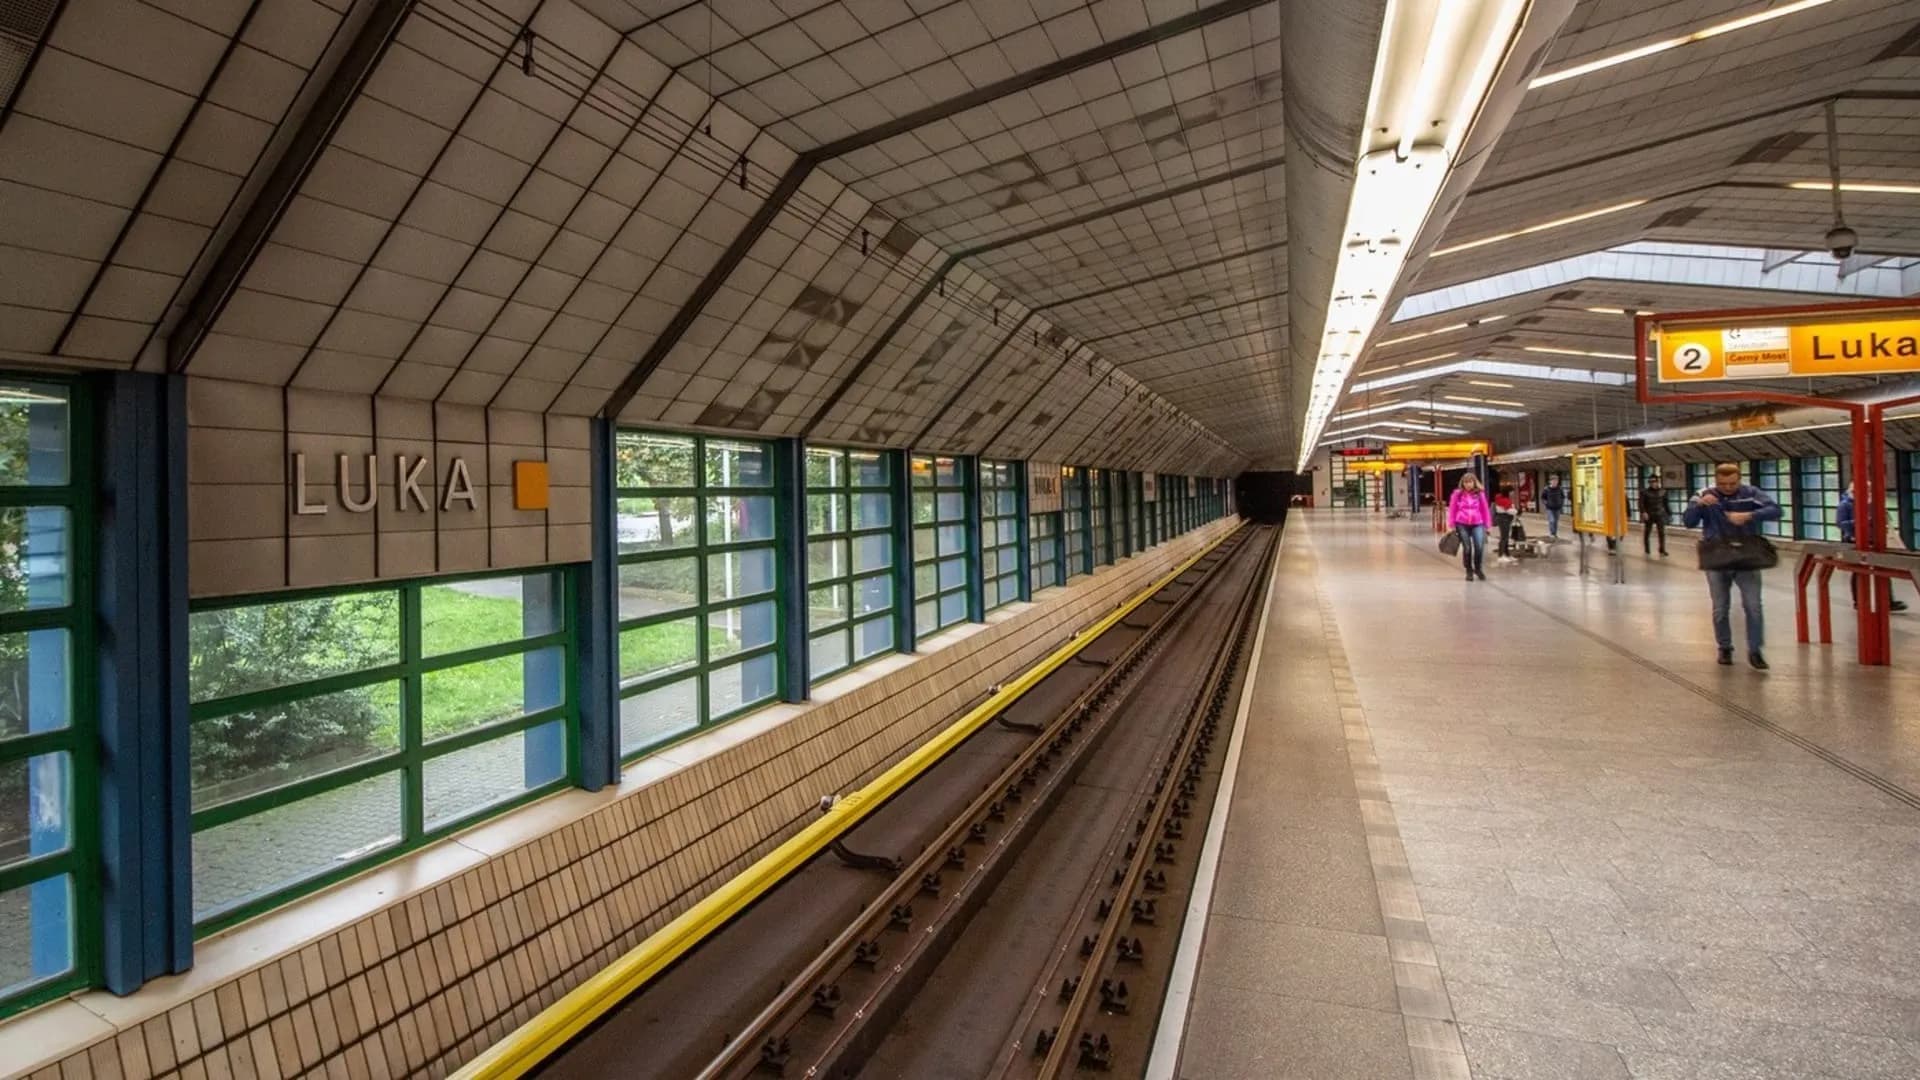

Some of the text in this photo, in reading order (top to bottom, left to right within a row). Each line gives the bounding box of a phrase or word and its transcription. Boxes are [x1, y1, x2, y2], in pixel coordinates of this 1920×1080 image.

[1683, 347, 1702, 370] 2
[1812, 331, 1919, 361] Luka
[294, 452, 477, 515] LUKA
